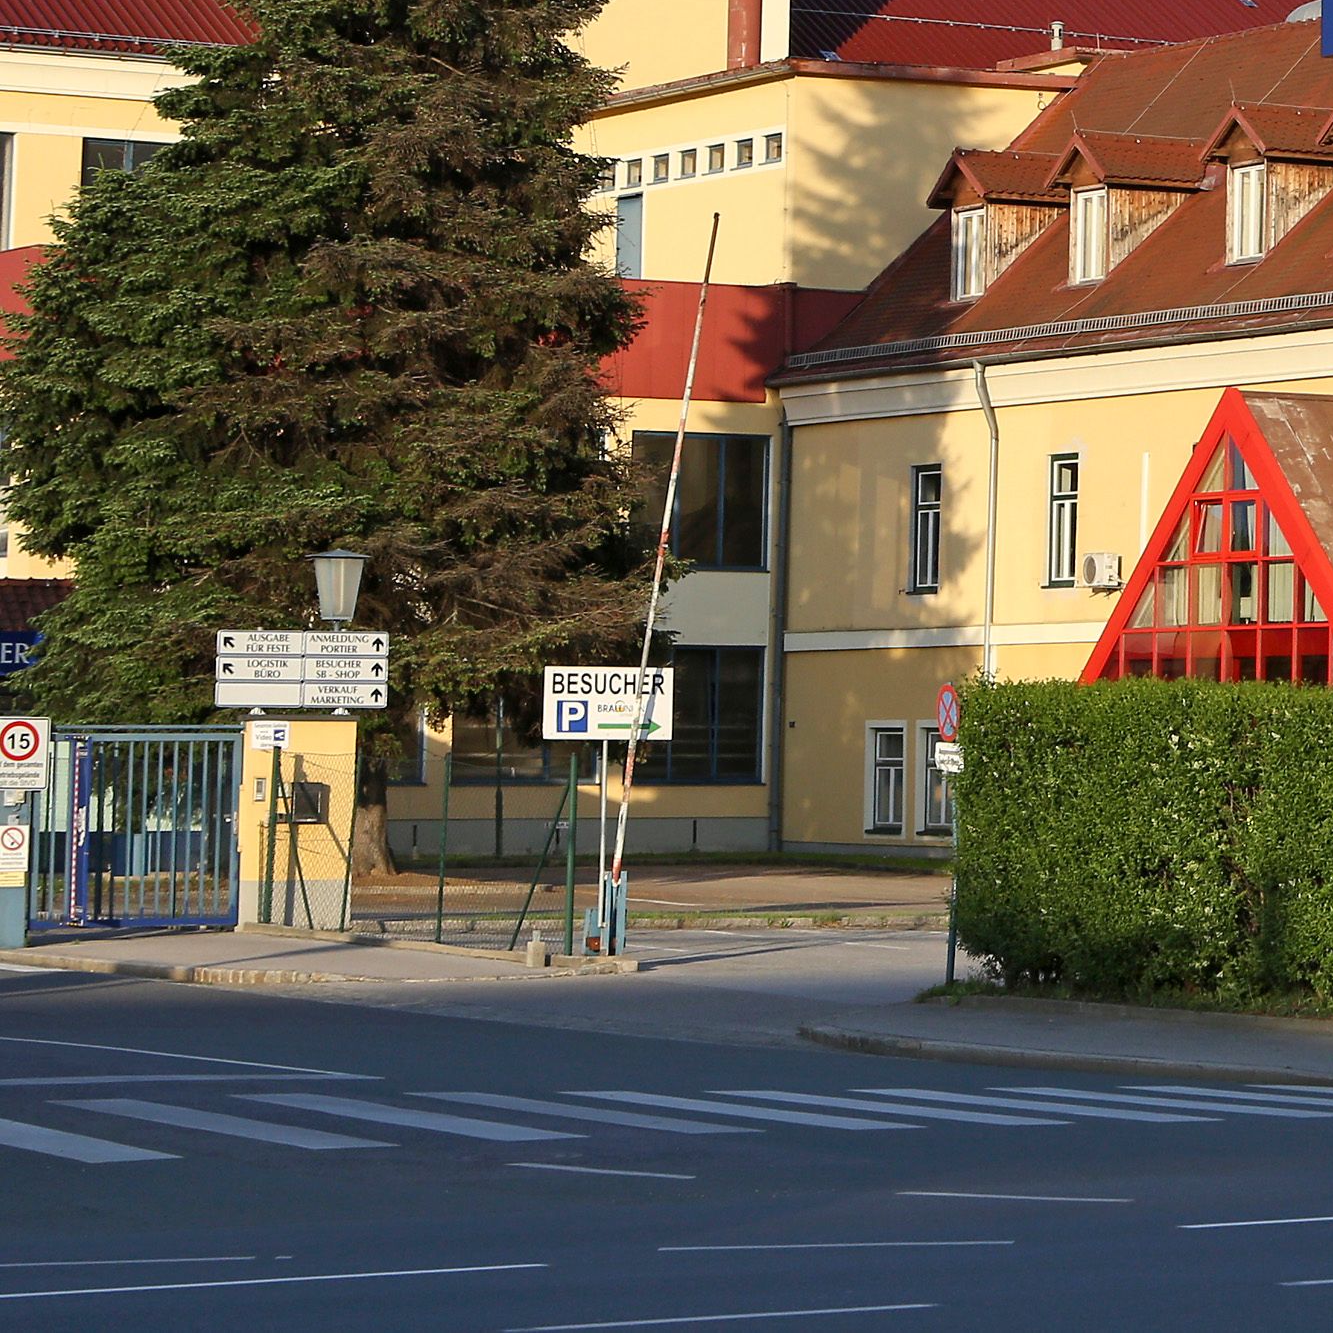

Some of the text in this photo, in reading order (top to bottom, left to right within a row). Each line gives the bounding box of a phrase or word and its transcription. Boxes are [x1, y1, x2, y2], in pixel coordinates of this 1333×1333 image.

[248, 634, 289, 642] AUSGABE
[309, 635, 369, 643] ANMELDUNG
[246, 642, 291, 653] FÜR FESTE
[320, 645, 358, 653] PORTIER
[0, 642, 30, 664] ER
[247, 659, 289, 668] LOGISTIK
[315, 660, 361, 668] BESUCHER
[254, 668, 281, 678] BÜRO
[316, 670, 328, 678] SB
[335, 670, 361, 679] SHOP
[552, 673, 665, 695] BESUCHER
[317, 686, 359, 694] VERKAUF
[310, 696, 365, 704] MARKETING
[7, 733, 30, 749] 15
